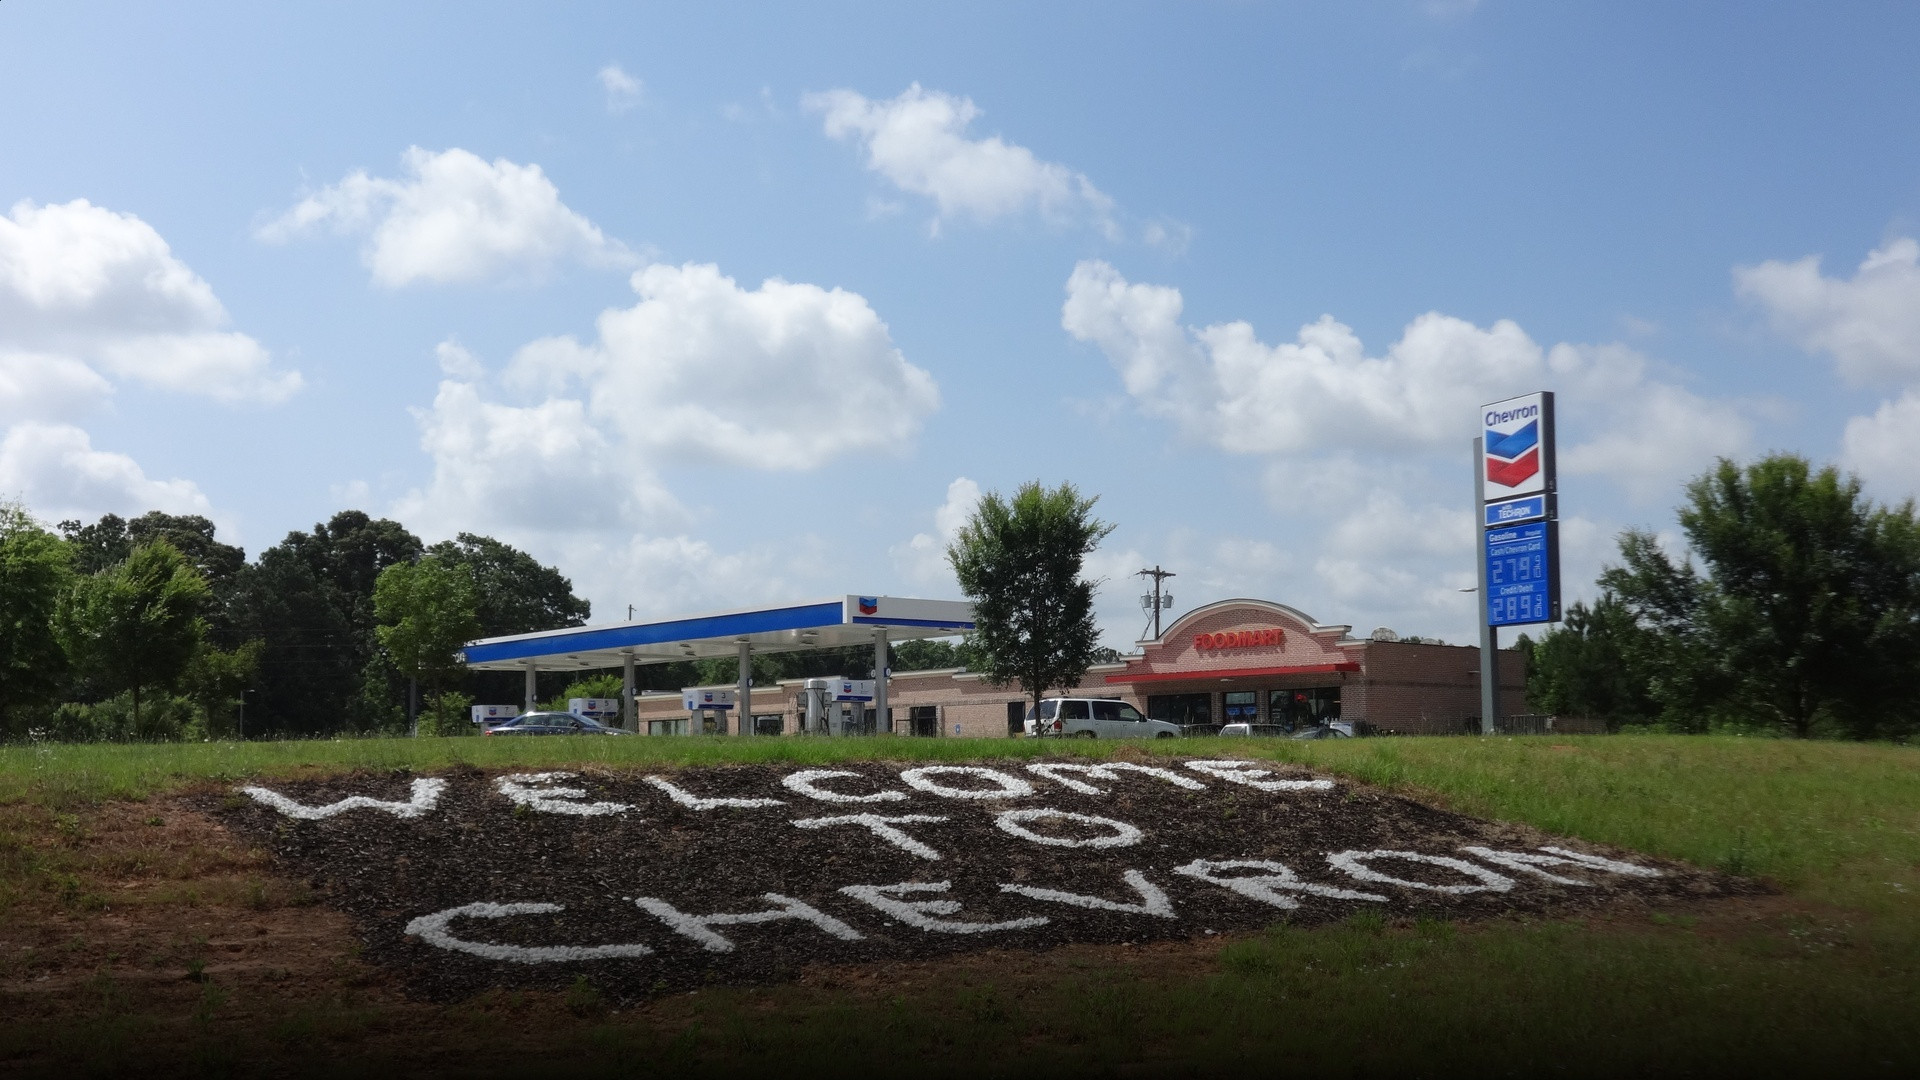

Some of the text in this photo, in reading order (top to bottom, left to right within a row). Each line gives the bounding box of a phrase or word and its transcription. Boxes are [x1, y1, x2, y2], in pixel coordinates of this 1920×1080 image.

[1485, 404, 1538, 427] Chevron
[1489, 531, 1517, 542] Gasoline
[1528, 542, 1541, 551] Card
[1500, 583, 1533, 595] Credit/Debit
[1193, 629, 1285, 650] FOODMART
[241, 760, 1334, 820] WELCOME
[791, 807, 1144, 862] TO
[404, 845, 1664, 965] CHEVRON
